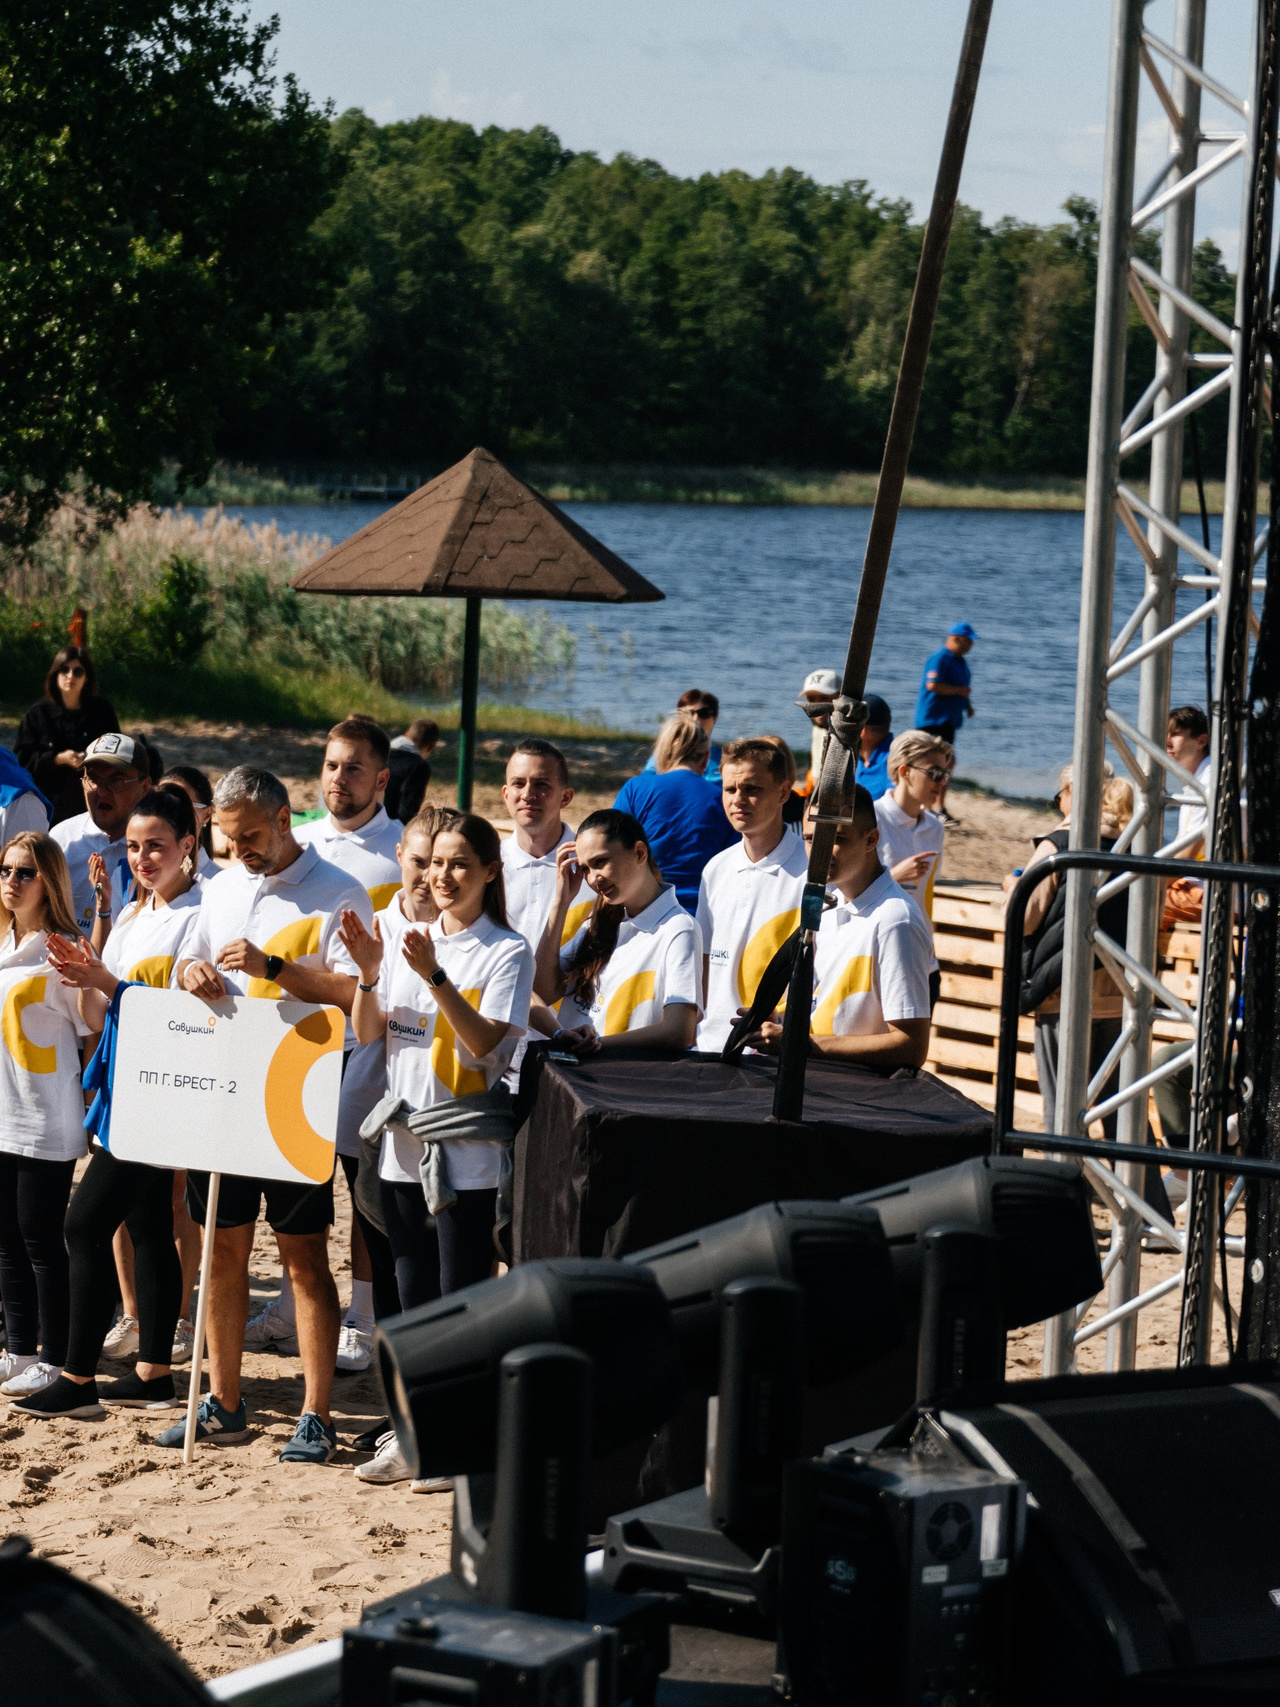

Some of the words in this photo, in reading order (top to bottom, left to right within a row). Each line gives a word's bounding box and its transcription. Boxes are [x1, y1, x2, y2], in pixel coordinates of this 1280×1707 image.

[168, 1020, 215, 1035] Савушкин
[139, 1070, 159, 1085] ПП
[162, 1073, 171, 1086] Г.
[174, 1074, 217, 1091] БРЕСТ
[227, 1080, 238, 1094] 2
